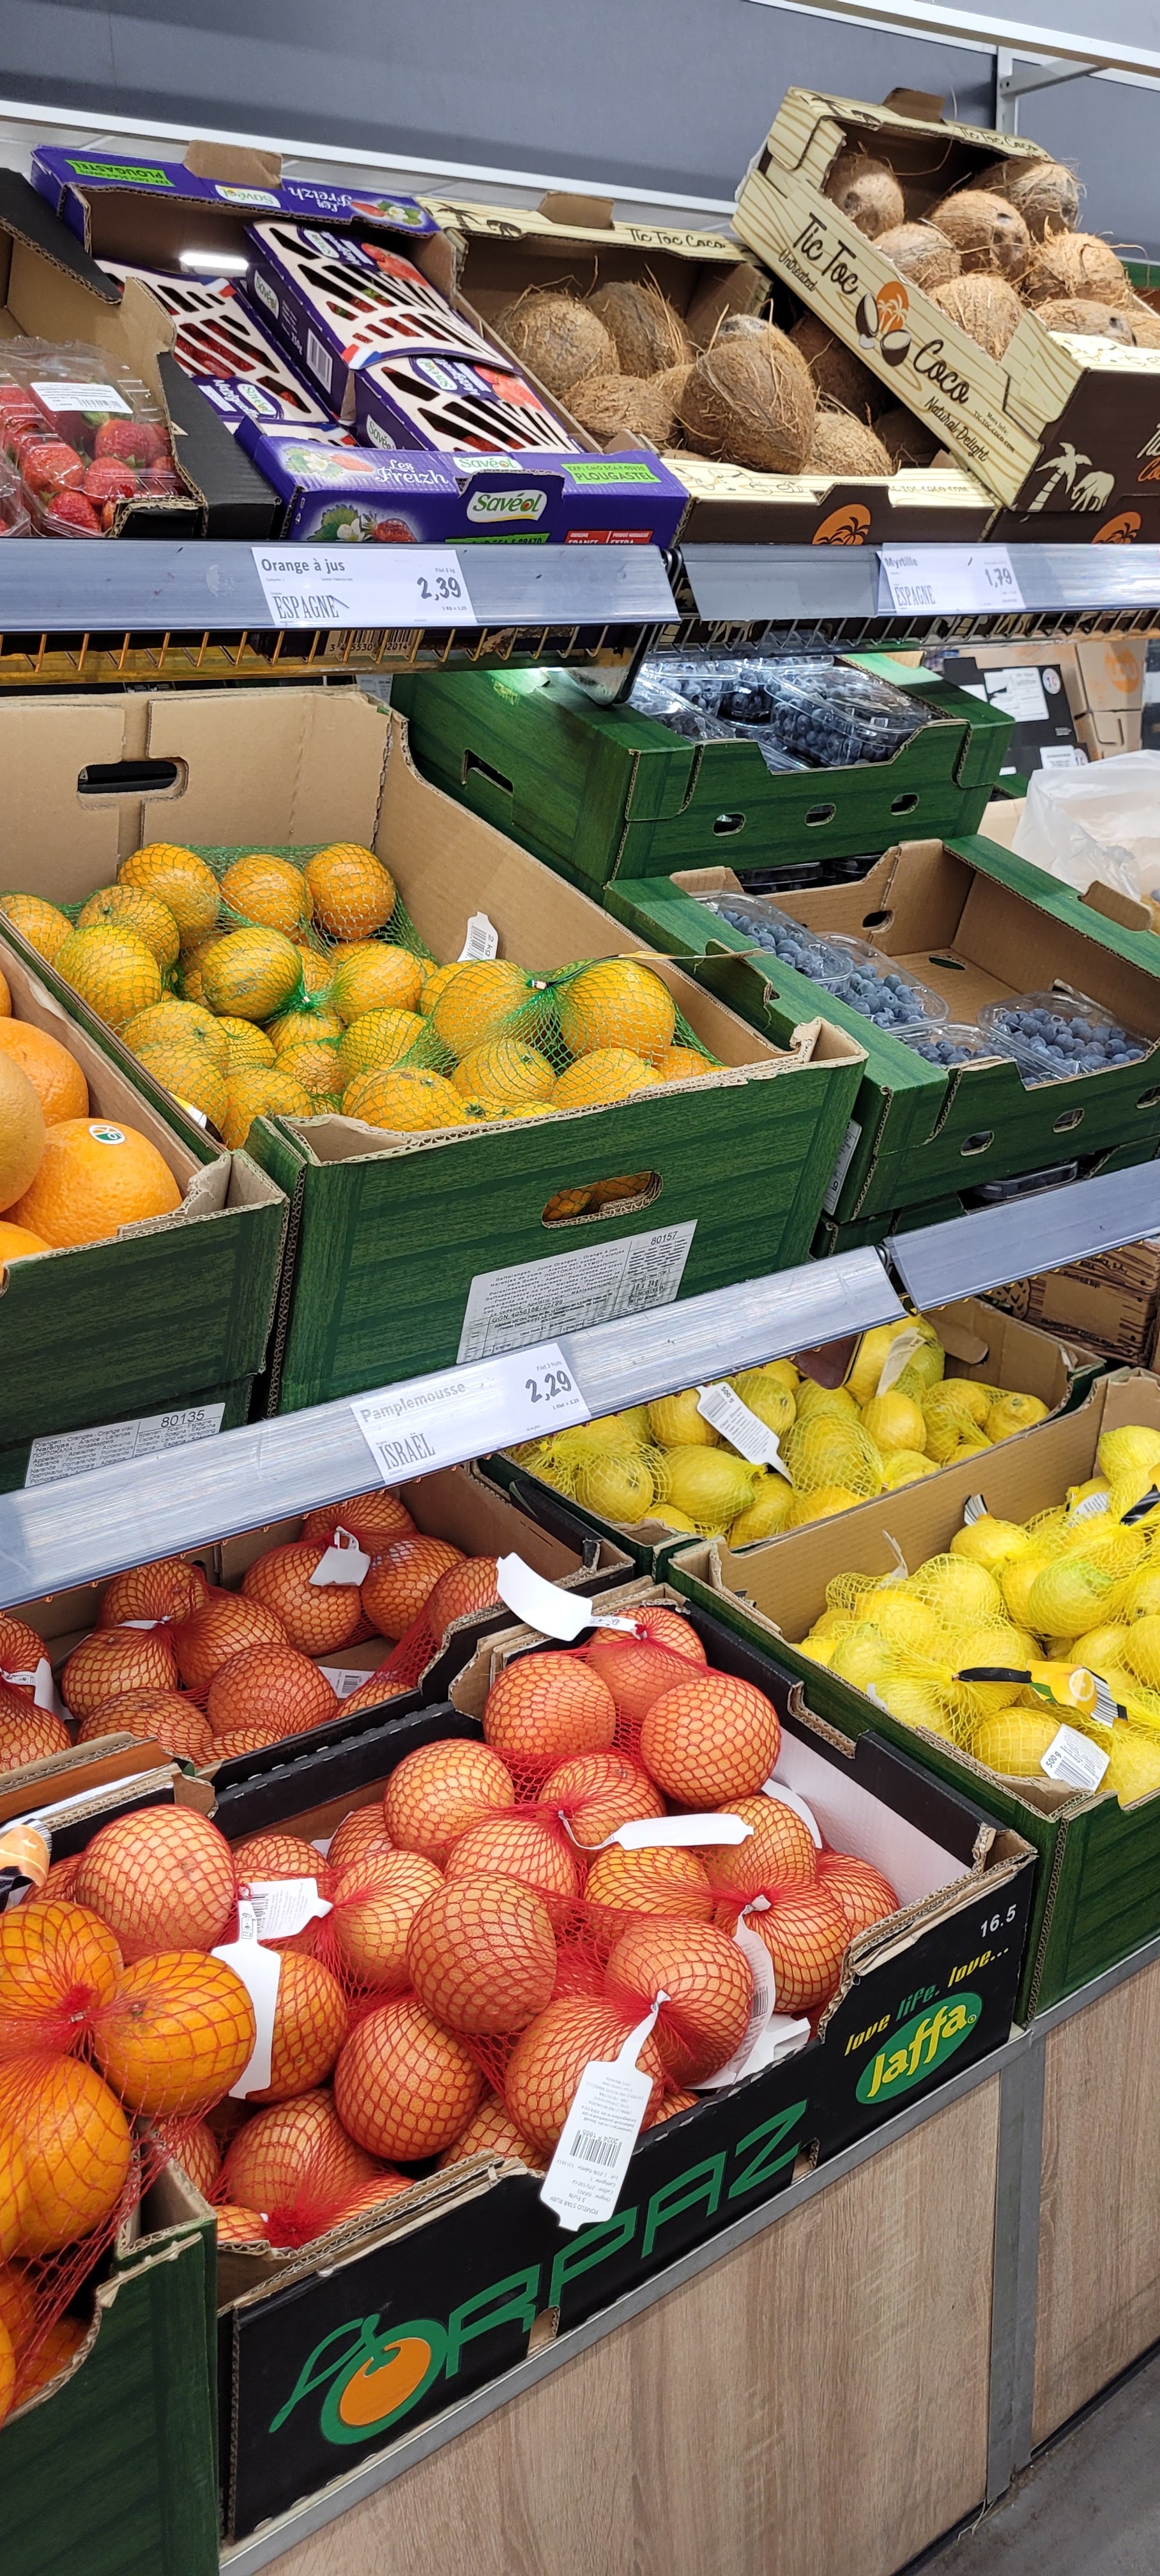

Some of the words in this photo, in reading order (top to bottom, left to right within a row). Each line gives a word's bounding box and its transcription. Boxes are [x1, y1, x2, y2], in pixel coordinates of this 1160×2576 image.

[75, 161, 164, 180] PLOUGASTEL
[288, 186, 353, 208] Freizh
[626, 228, 653, 242] Tic
[651, 231, 683, 245] Toc
[685, 234, 726, 249] Coco
[792, 211, 828, 262] Tic
[821, 239, 859, 295] Toc
[777, 247, 818, 293] Untreated
[256, 276, 277, 314] Savéol
[913, 339, 970, 405] Coco
[924, 395, 962, 434] Natural
[956, 424, 989, 462] Delight
[390, 458, 415, 471] Les
[460, 457, 517, 470] Savéol
[375, 466, 450, 485] Freizh
[576, 471, 655, 480] PLOUGASTEL
[472, 493, 543, 512] Savéol
[261, 558, 310, 574] Orange
[313, 558, 322, 571] à
[324, 558, 346, 574] jus
[884, 556, 919, 569] Myrtille
[985, 567, 1012, 588] 1,79
[417, 577, 461, 601] 2,39
[894, 585, 936, 606] ESPAGNE
[272, 595, 340, 619] ESPAGNE
[489, 934, 494, 942] 2
[485, 944, 493, 957] kg
[651, 1230, 678, 1245] 80157
[492, 1314, 509, 1323] GGN
[525, 1370, 572, 1403] 2,29
[720, 1386, 731, 1398] 500
[360, 1383, 466, 1423] Pamplemousse
[161, 1409, 205, 1428] 80135
[192, 1423, 216, 1432] Espanha
[139, 1430, 162, 1438] Spanien
[187, 1420, 212, 1429] Espagne
[162, 1435, 176, 1443] Land
[188, 1429, 216, 1438] oorsprong
[34, 1439, 61, 1448] Orangen
[67, 1433, 93, 1443] Oranges
[36, 1443, 70, 1453] Naranjas
[105, 1432, 131, 1441] Laranjas
[136, 1444, 156, 1454] Spanje
[33, 1454, 63, 1464] Appelsiini
[69, 1448, 97, 1457] Apelsiner
[102, 1441, 134, 1450] Appelsiner
[378, 1432, 436, 1470] ISRAËL
[66, 1462, 95, 1471] Portocale
[1046, 1753, 1058, 1769] 500
[1054, 1750, 1062, 1759] g
[980, 1904, 1017, 1938] 16.5
[844, 2014, 891, 2057] love
[896, 1984, 940, 2021] life.
[866, 2004, 967, 2098] Jaffa
[582, 2129, 597, 2139] 1865
[603, 2135, 619, 2145] 2024
[549, 2195, 564, 2205] RUBY
[563, 2200, 577, 2209] STAR
[569, 2193, 582, 2202] fruits
[595, 2195, 611, 2203] Origine
[577, 2204, 600, 2216] POMELO
